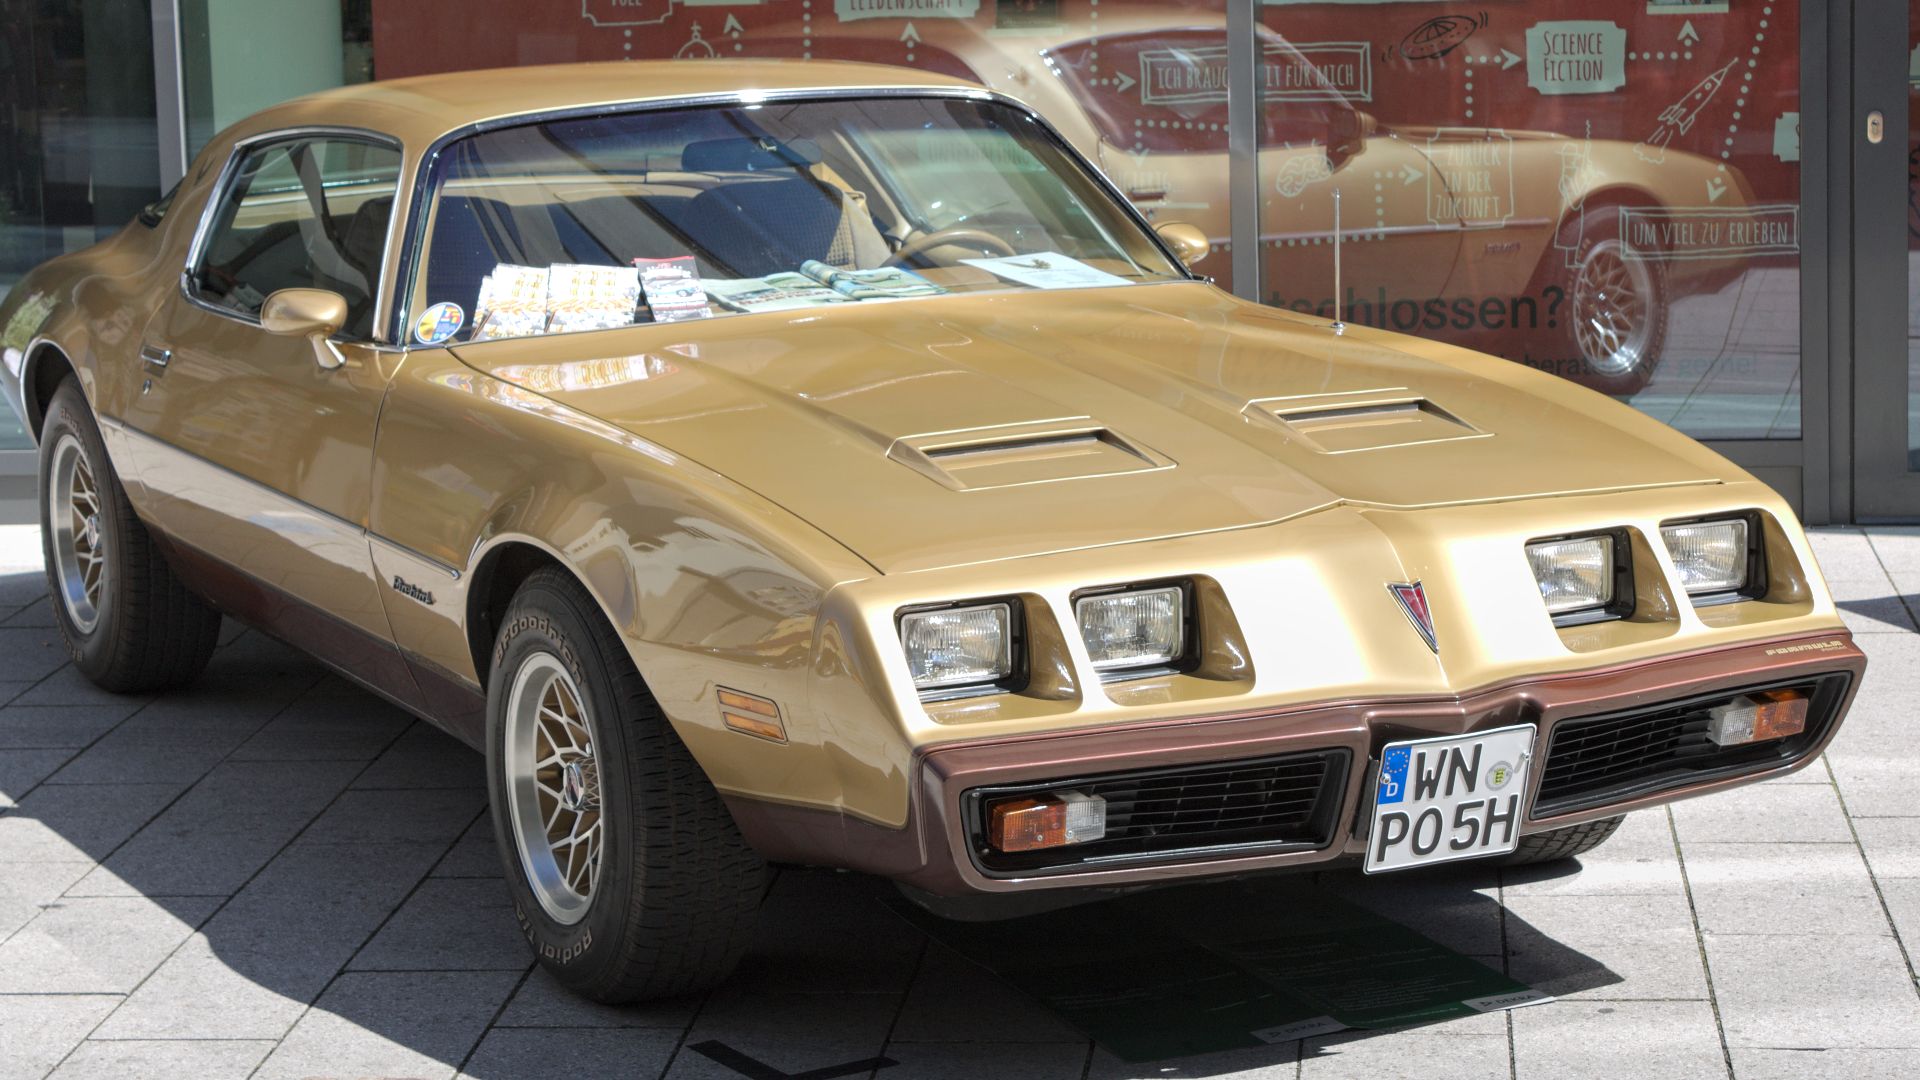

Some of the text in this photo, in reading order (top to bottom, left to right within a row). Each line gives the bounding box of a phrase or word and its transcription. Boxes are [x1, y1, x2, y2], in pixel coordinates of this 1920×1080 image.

[1543, 30, 1604, 56] SCIENCE
[1157, 65, 1181, 89] ICH
[1285, 60, 1312, 88] FÜR
[1316, 63, 1354, 87] MICH
[1543, 58, 1603, 82] FICTION
[1466, 171, 1492, 193] DER
[1435, 193, 1501, 219] ZUKUNFT
[1633, 220, 1789, 246] UM VIEL ZU ERLEBEN
[1414, 743, 1484, 801] WN
[1385, 782, 1399, 798] D
[538, 927, 593, 965] Radial
